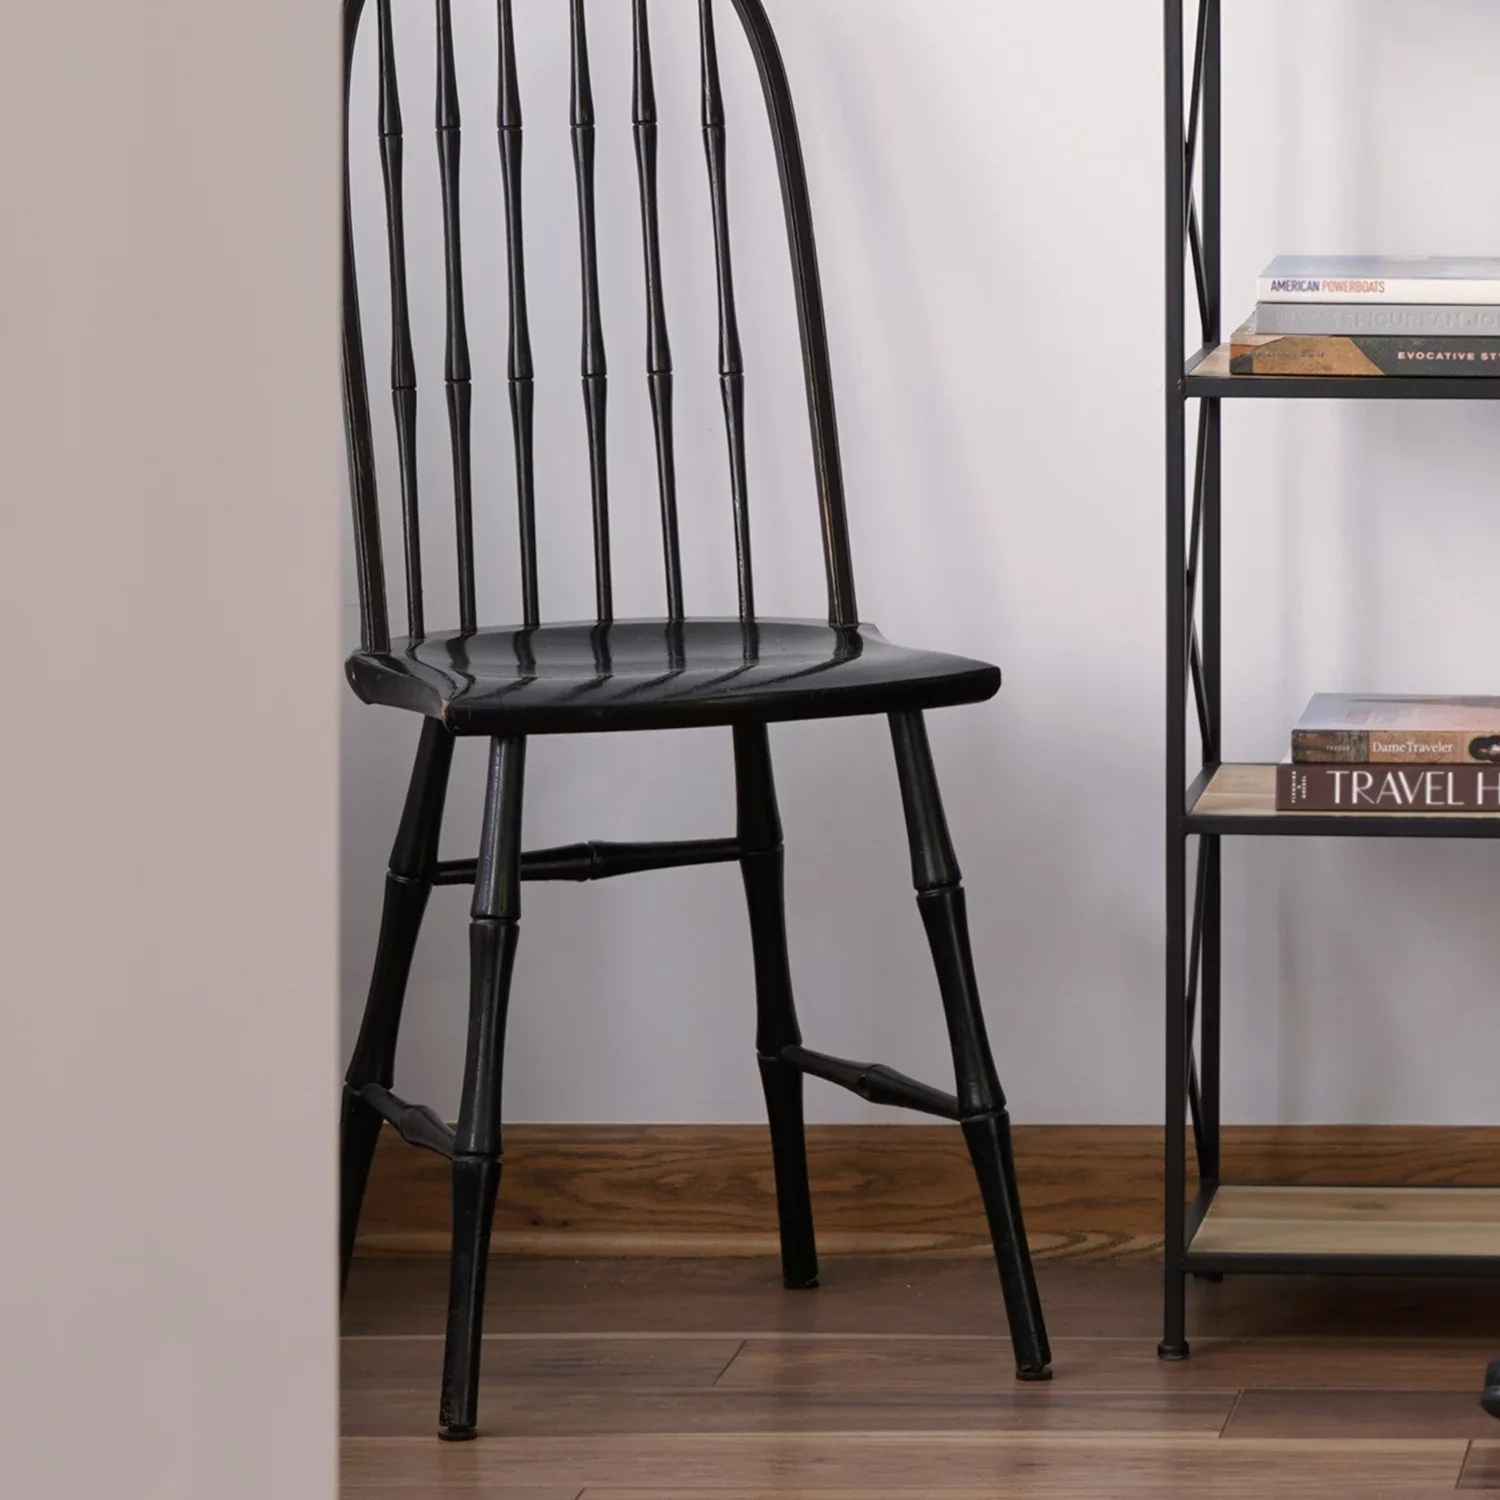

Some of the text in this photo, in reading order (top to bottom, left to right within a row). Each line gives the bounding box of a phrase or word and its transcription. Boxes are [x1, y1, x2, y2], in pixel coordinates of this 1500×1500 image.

[1270, 279, 1385, 293] AMERICAN POWERBOATS
[1397, 351, 1475, 360] EVOCATIVE
[1326, 770, 1464, 806] TRAVEL
